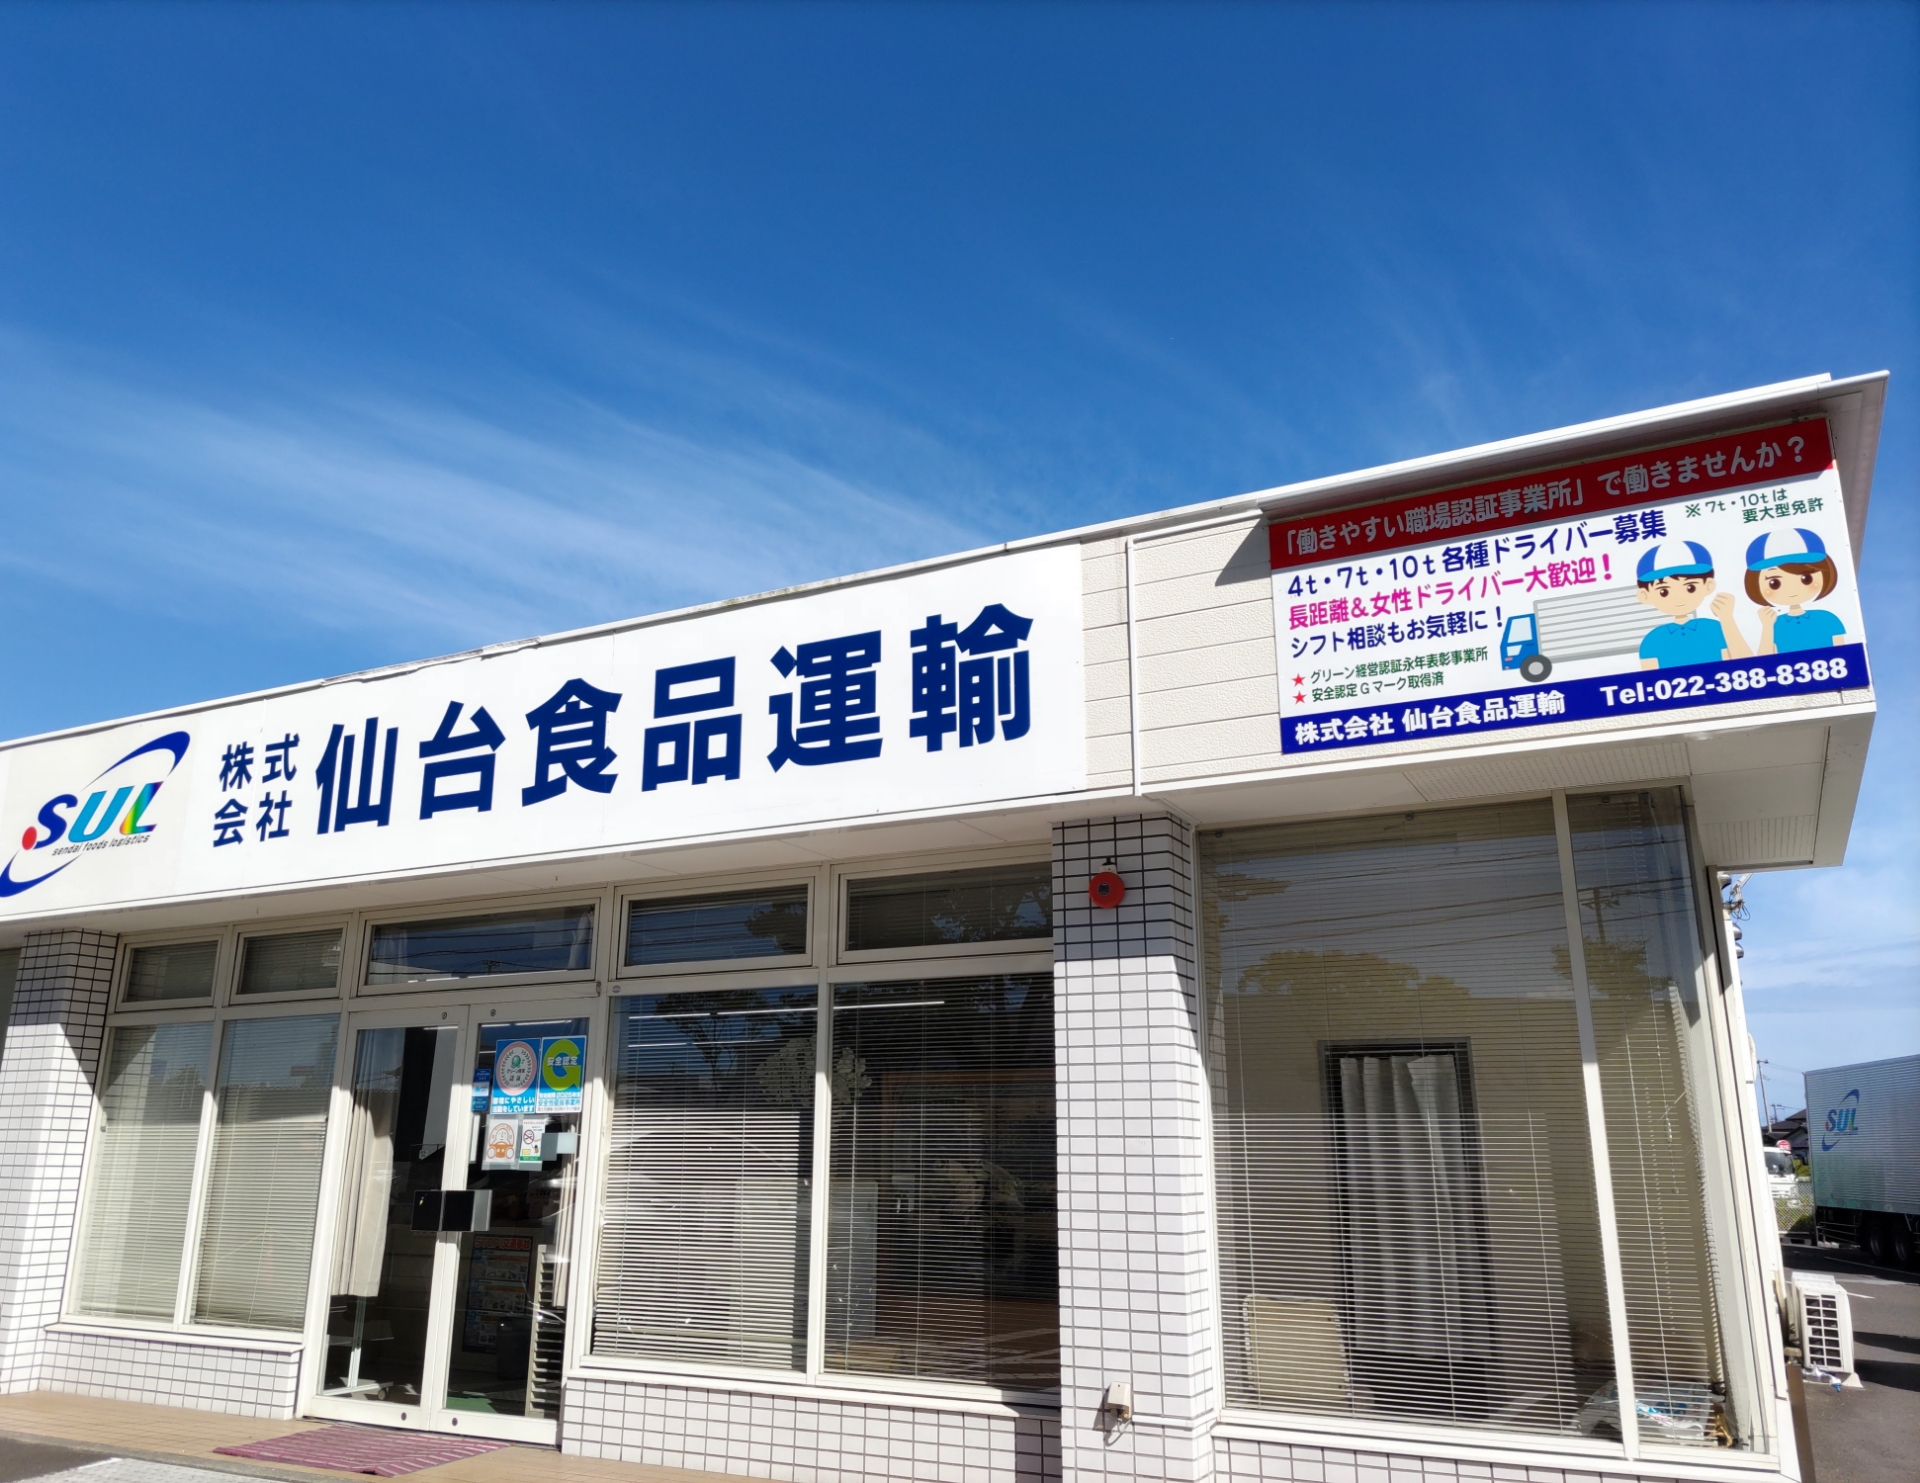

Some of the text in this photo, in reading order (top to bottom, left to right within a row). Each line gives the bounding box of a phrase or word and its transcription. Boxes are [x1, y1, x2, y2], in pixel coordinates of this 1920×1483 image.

[1742, 497, 1824, 524] 要大型免許
[1310, 646, 1488, 684] グリーン経営認証永年表彰事業所
[1600, 657, 1848, 706] Tel:022-388-8388
[315, 603, 1034, 835] 仙台食品運輸
[1295, 690, 1566, 745] 株式会社 仙台食品運輸
[218, 733, 300, 792] 株式
[33, 781, 164, 850] SUL
[213, 790, 293, 848] 会社
[52, 834, 151, 856] sendai foods logistics
[1828, 1108, 1859, 1132] SUL
